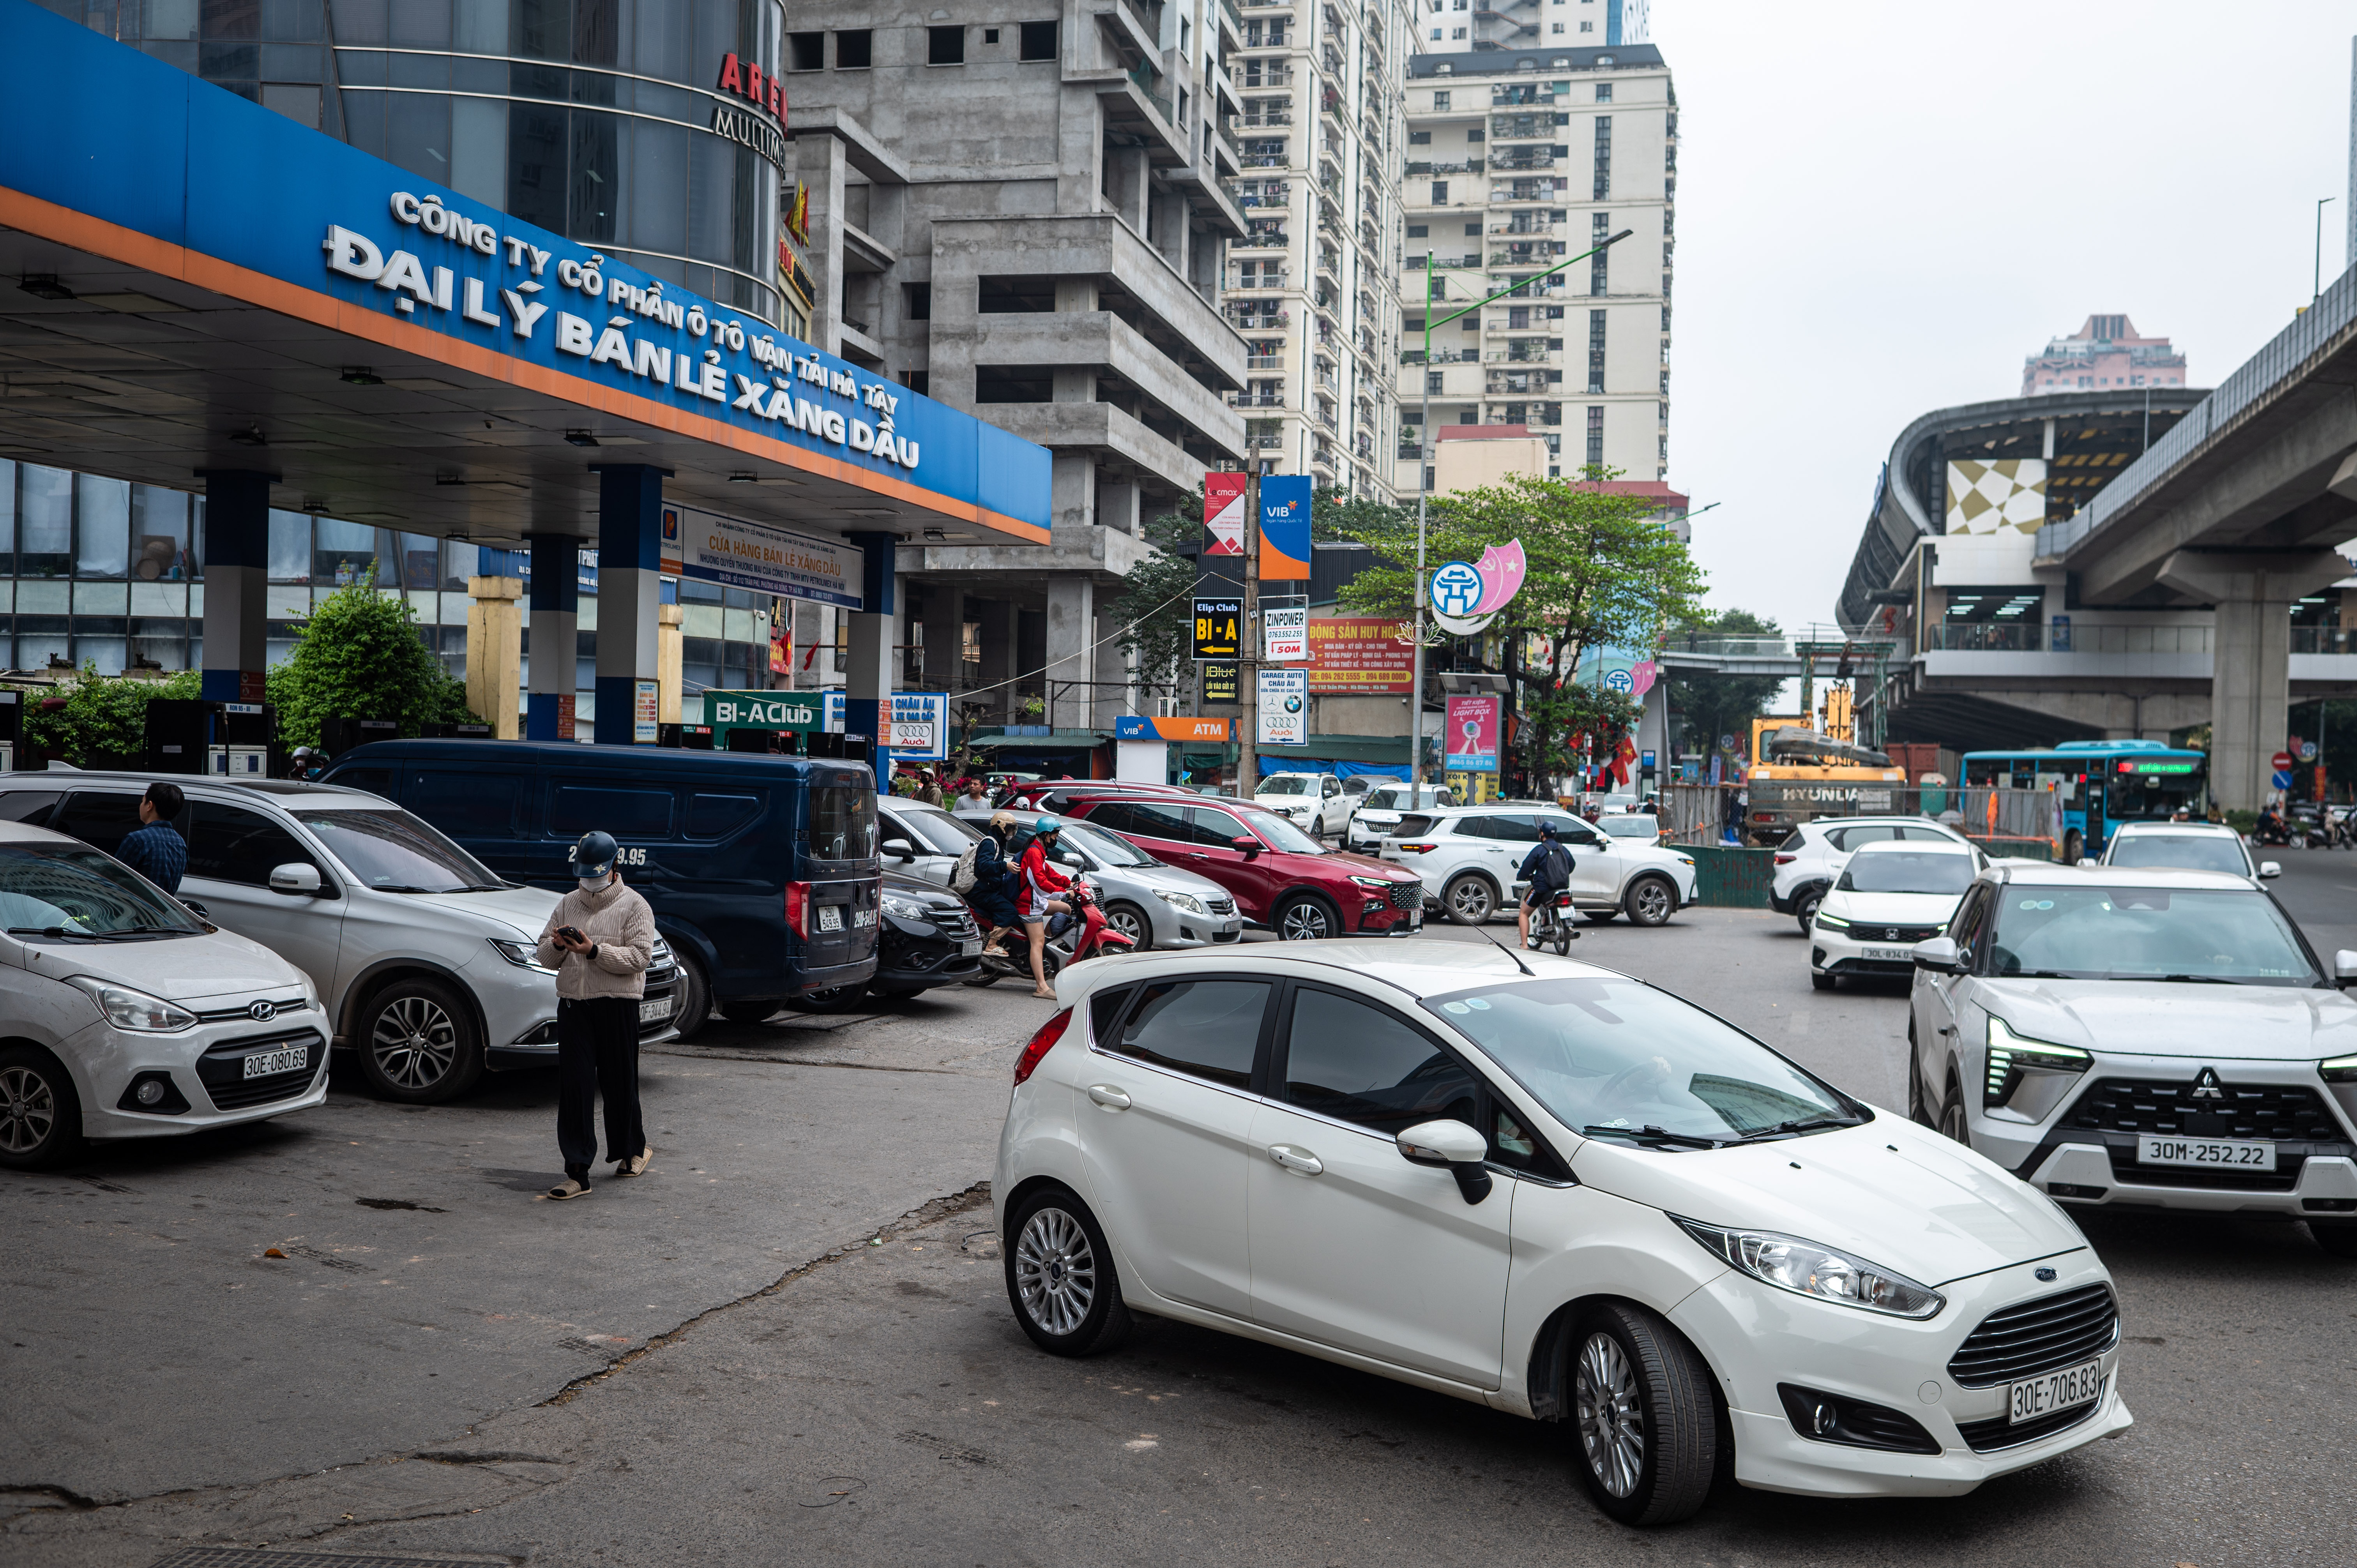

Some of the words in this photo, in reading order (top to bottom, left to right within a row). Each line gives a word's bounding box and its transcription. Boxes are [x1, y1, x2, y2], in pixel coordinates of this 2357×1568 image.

[390, 191, 496, 254] CÔNG
[503, 236, 551, 275] TY
[558, 254, 604, 296] CỔ
[608, 281, 684, 329] PHẦN
[687, 305, 707, 336] Ô
[710, 320, 744, 351] TÔ
[747, 335, 792, 373] VẬN
[795, 353, 828, 387] TẢI
[830, 369, 858, 400] HÀ
[861, 384, 898, 415] TÂY
[323, 224, 454, 313] ĐẠI
[463, 281, 549, 338] LÝ
[556, 311, 671, 383] BÁN
[675, 350, 726, 402] LẺ
[732, 373, 845, 444] XĂNG
[849, 412, 919, 468] DẦU
[1267, 507, 1289, 517] VIB
[660, 542, 681, 551] ETROLIMEX
[709, 531, 730, 553] CỬA
[734, 539, 760, 559] HÀNG
[764, 546, 782, 564] BÁN
[785, 549, 795, 567] LẺ
[798, 553, 822, 572] XĂNG
[823, 556, 841, 576] DẦU
[700, 553, 719, 567] NHƯỢNG
[721, 556, 735, 569] QUYỀN
[736, 561, 753, 572] THƯƠNG
[763, 563, 771, 576] CỦA
[772, 567, 783, 578] CÔNG
[784, 570, 790, 579] TY
[790, 572, 800, 581] TNHH
[801, 574, 809, 583] MTV
[810, 576, 832, 588] PETROLIMEX
[832, 580, 837, 589] HÀ
[1197, 604, 1214, 613] Elip
[1267, 612, 1303, 626] ZINPOWER
[1309, 624, 1335, 641] ĐỘNG
[1338, 622, 1358, 639] SẢN
[1360, 625, 1378, 639] HUY
[896, 696, 919, 709] CHÂU
[923, 697, 935, 709] ÂU
[922, 710, 935, 720] CẤP
[1194, 724, 1221, 735] ATM
[1783, 787, 1858, 801] HYUNDA
[825, 907, 834, 917] 29D
[823, 918, 839, 929] 549.95
[640, 1001, 670, 1020] 0F-344.94
[246, 1049, 305, 1076] 30E-080.69
[2150, 1142, 2263, 1165] 30M-252.22
[2014, 1365, 2096, 1417] 30E-706.83
